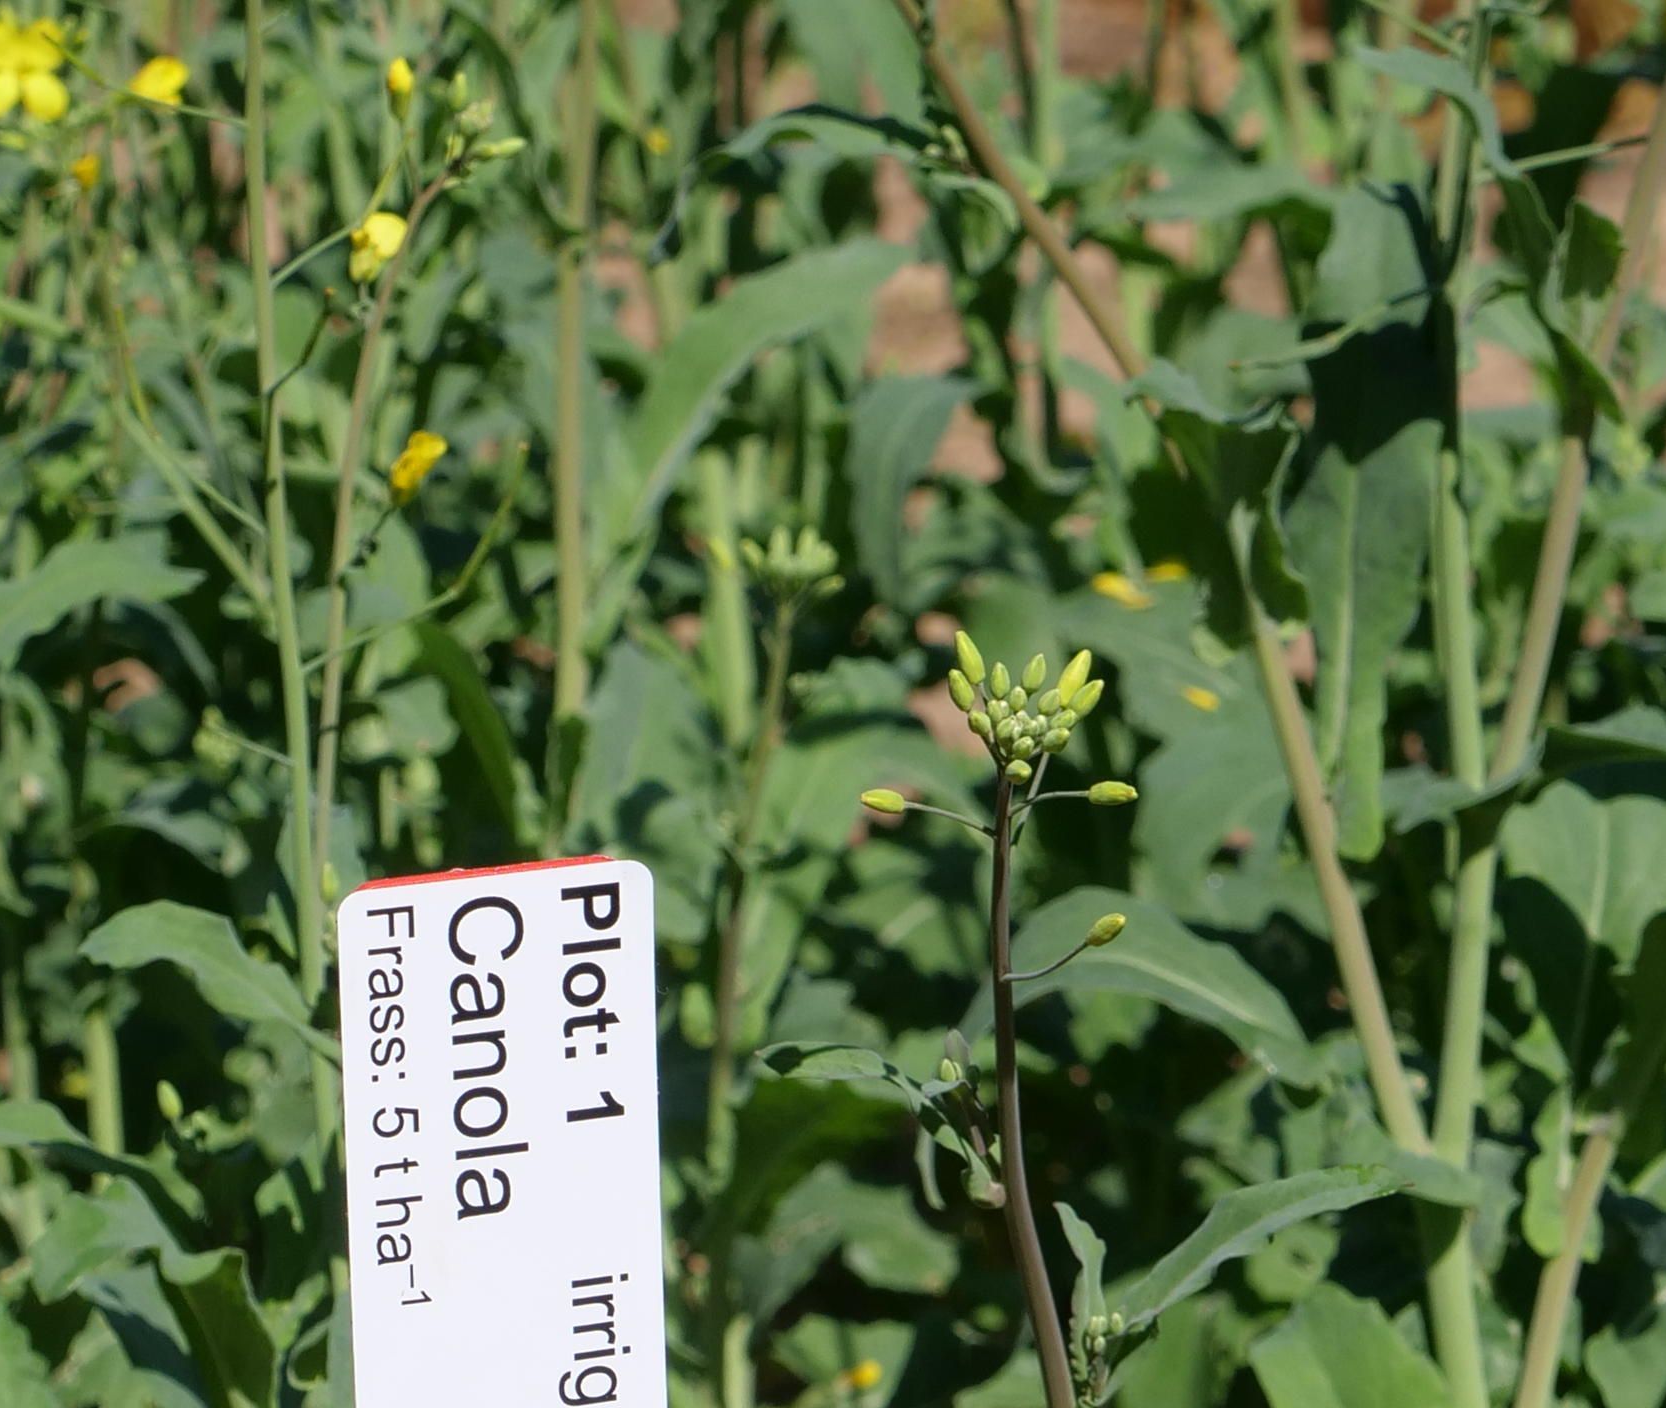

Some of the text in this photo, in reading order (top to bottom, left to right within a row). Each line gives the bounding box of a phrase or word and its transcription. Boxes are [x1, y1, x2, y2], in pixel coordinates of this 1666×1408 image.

[366, 904, 415, 1084] Frass:
[560, 881, 621, 1060] Plot:
[448, 895, 529, 1222] Canola
[566, 1091, 625, 1123] 1
[372, 1107, 420, 1138] 5
[374, 1157, 419, 1179] t
